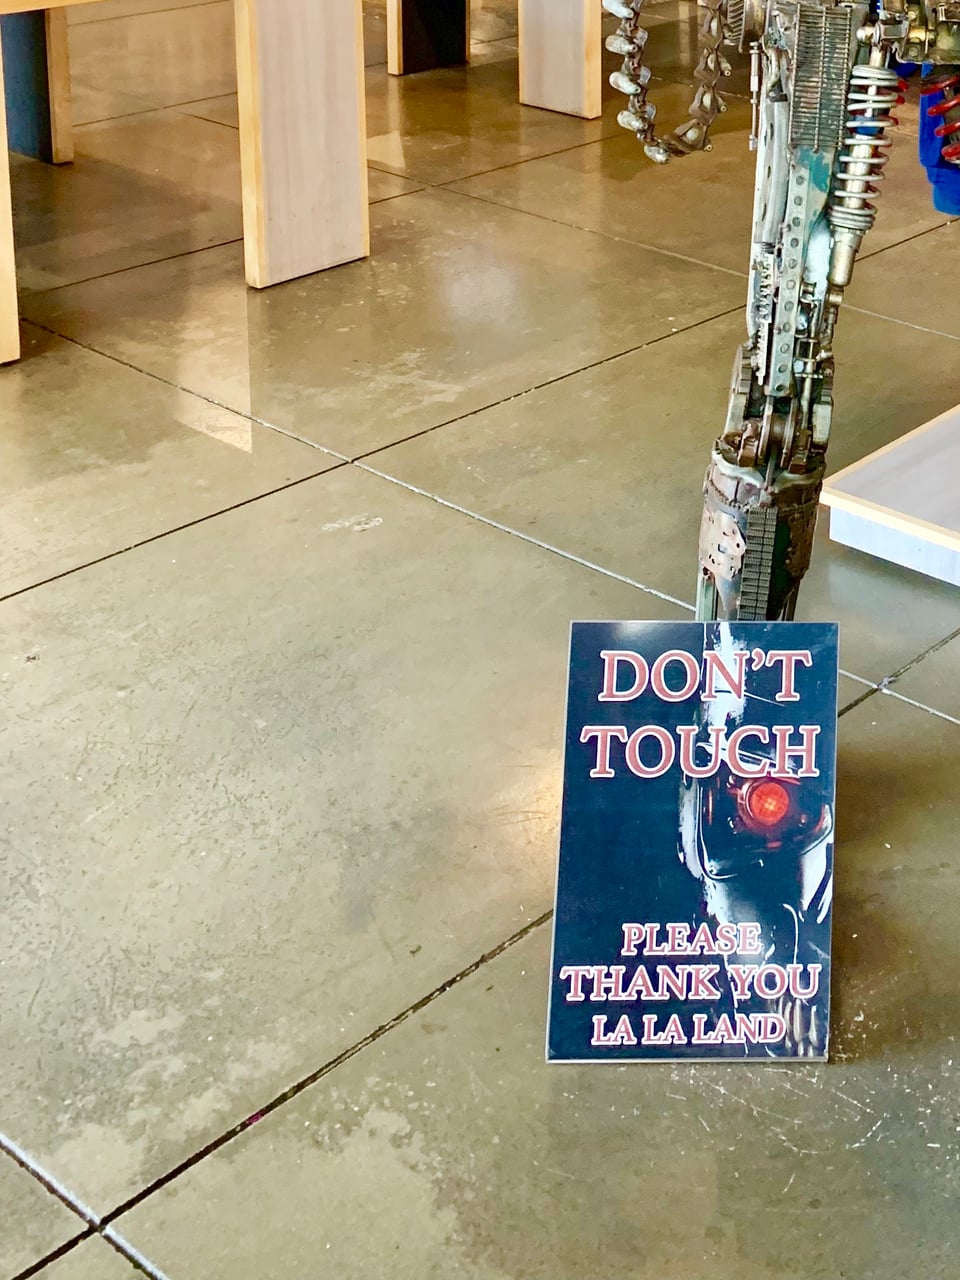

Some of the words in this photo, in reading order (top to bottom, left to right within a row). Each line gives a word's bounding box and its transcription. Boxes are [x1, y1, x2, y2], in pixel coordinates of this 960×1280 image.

[597, 649, 812, 702] DON'T
[579, 724, 821, 779] TOUCH
[620, 922, 762, 956] PLEASE
[559, 964, 721, 1002] THANK
[724, 963, 822, 1000] YOU
[590, 1014, 638, 1046] LA
[643, 1015, 687, 1045] LA
[692, 1014, 787, 1045] LAND
